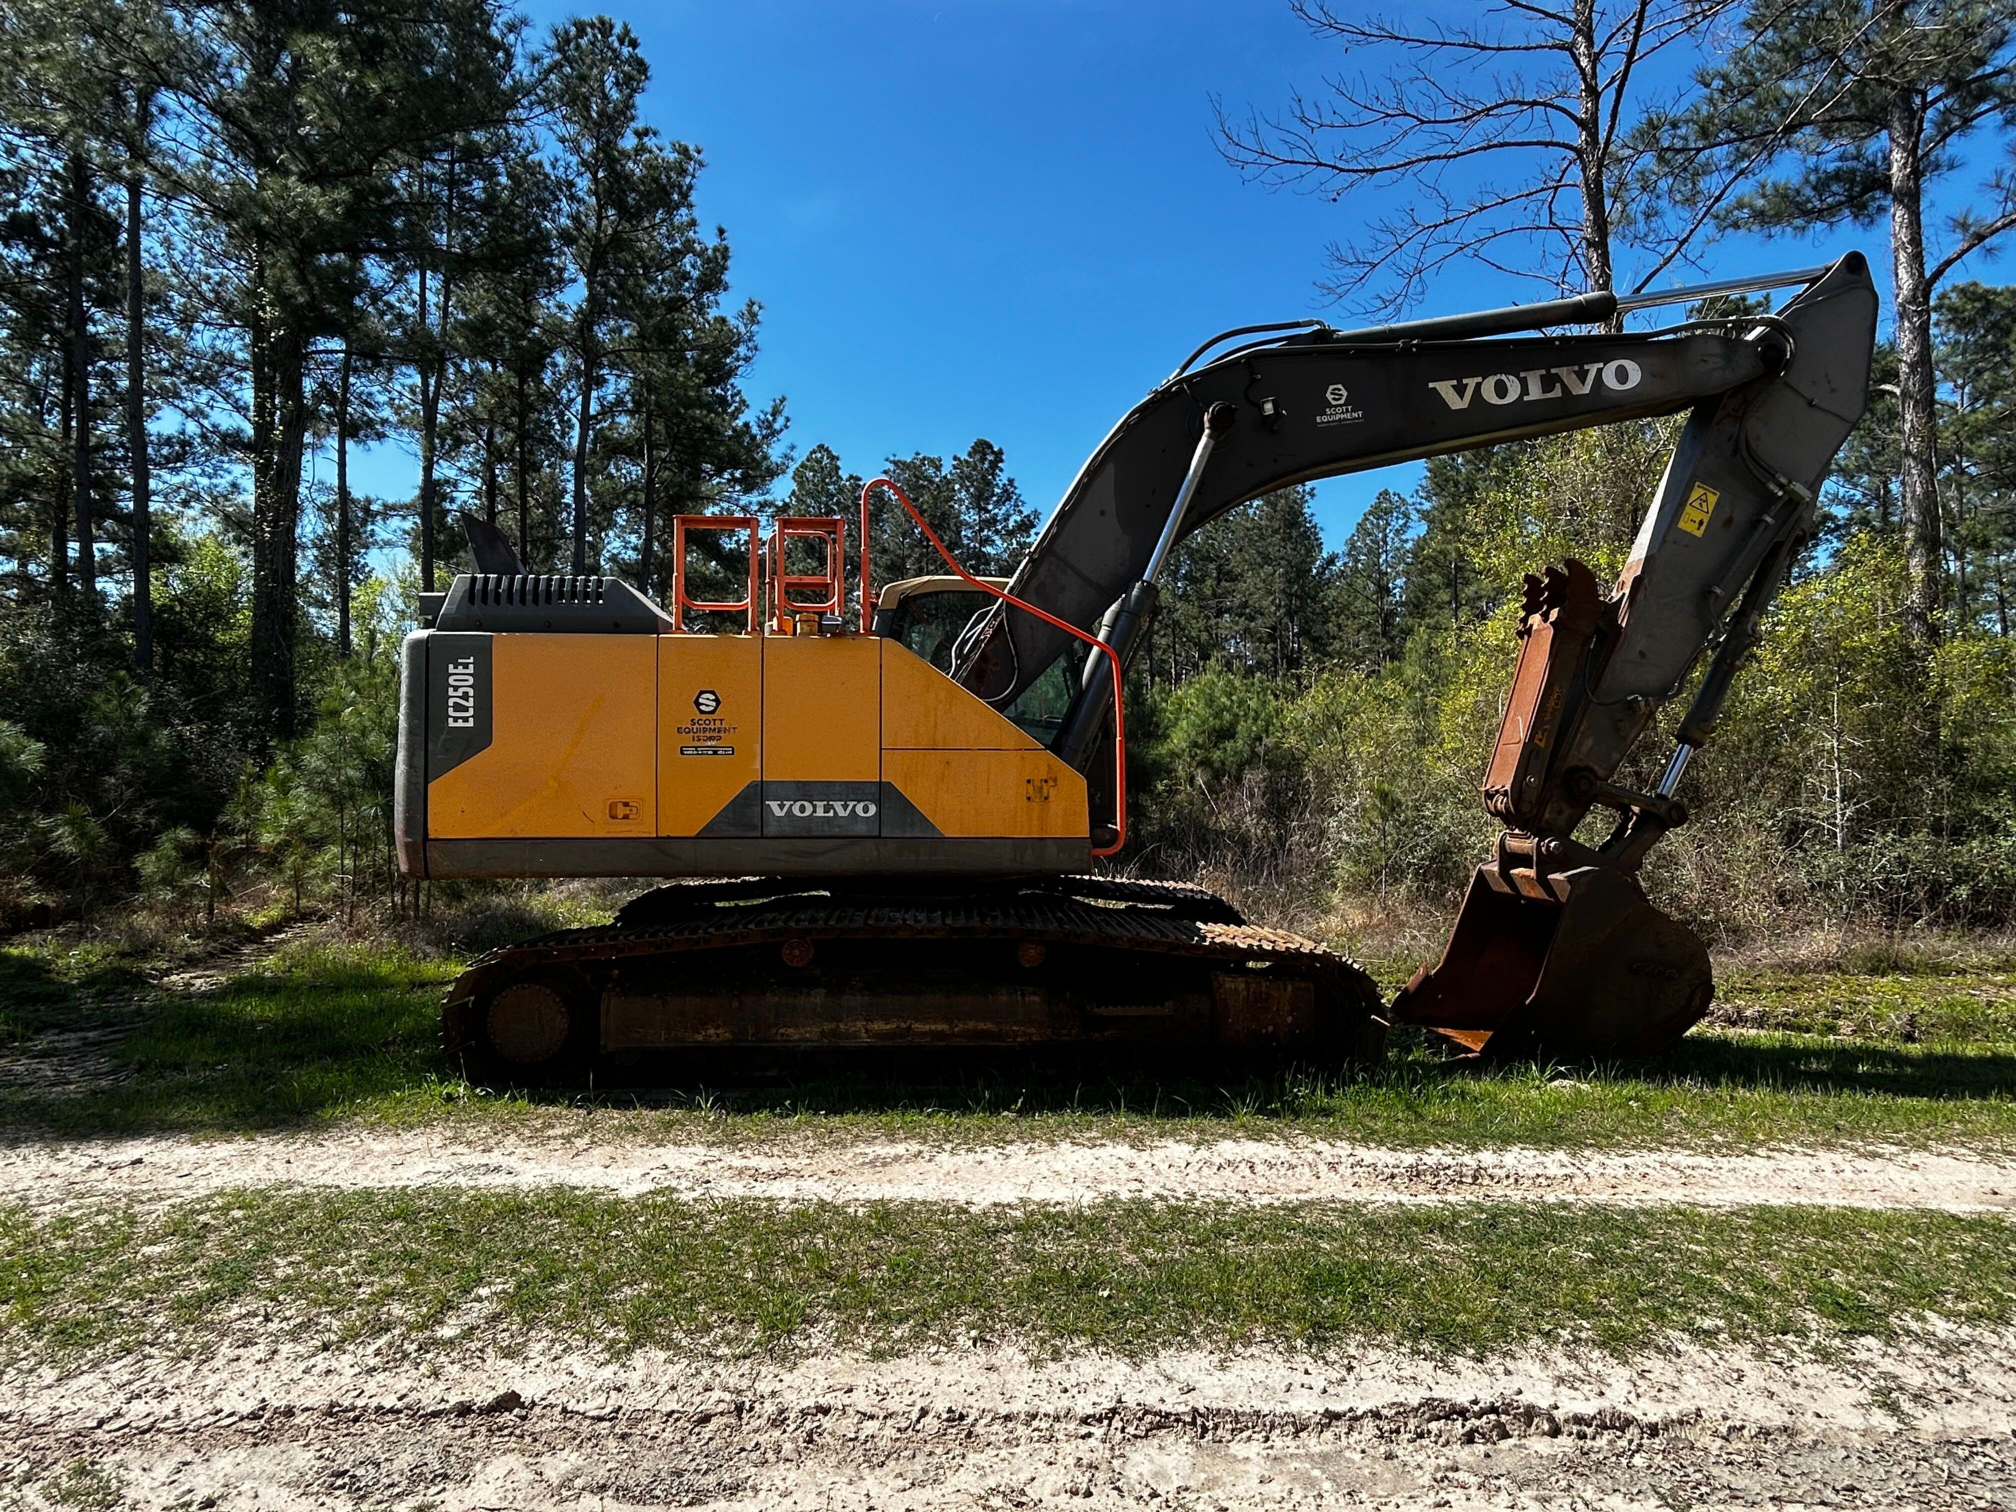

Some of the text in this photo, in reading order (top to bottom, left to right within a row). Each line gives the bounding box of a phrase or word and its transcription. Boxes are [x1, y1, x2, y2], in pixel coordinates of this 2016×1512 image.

[1428, 359, 1642, 410] VOLVO
[1316, 410, 1364, 423] EQUIPMENT
[1325, 405, 1353, 415] SCOTT
[448, 656, 474, 727] EC250EL
[690, 718, 725, 726] SCOTT
[676, 726, 738, 734] EQUIPMENT
[765, 800, 877, 817] VOLVO
